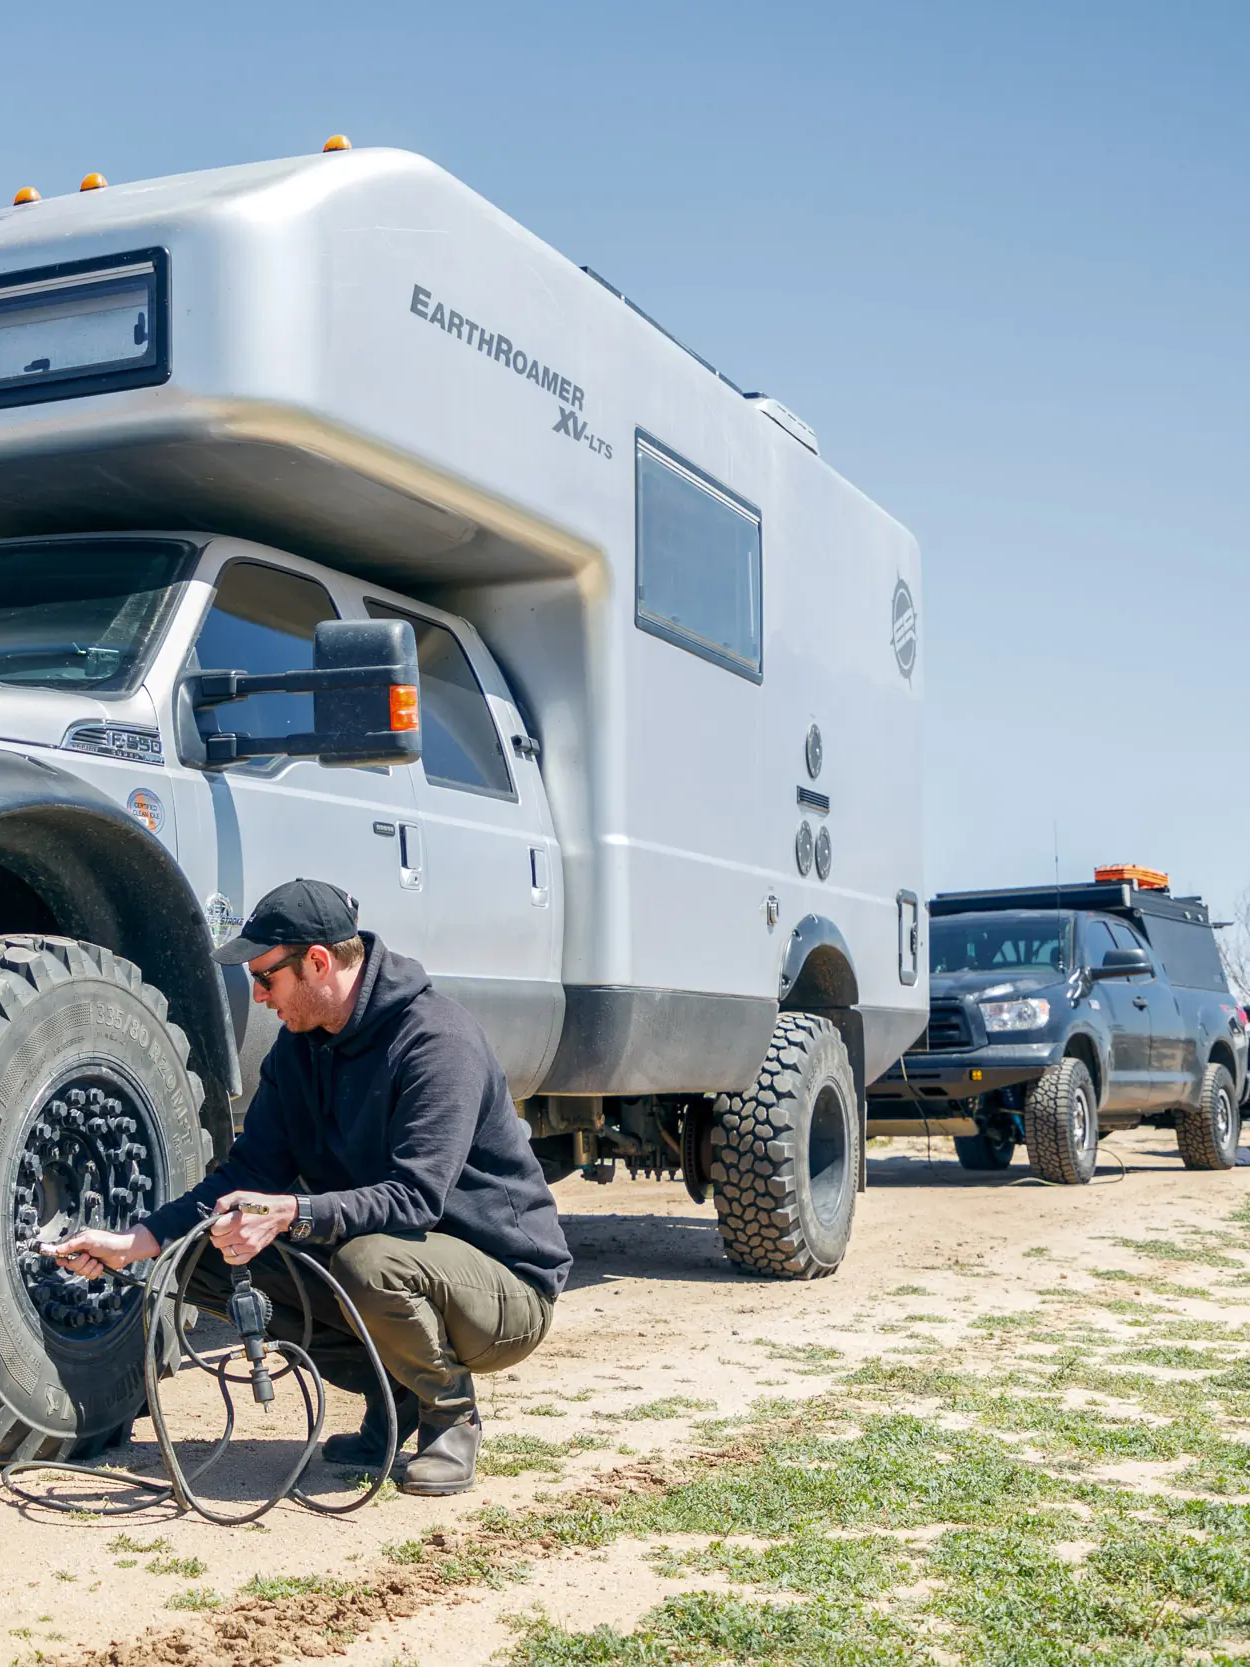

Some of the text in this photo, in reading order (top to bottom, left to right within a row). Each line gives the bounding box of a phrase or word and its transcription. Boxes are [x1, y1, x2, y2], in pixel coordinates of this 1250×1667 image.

[410, 284, 585, 412] EARTHROAMER
[552, 405, 613, 460] XV-LTS
[96, 1002, 149, 1049] 335/80
[149, 1037, 178, 1092] R20
